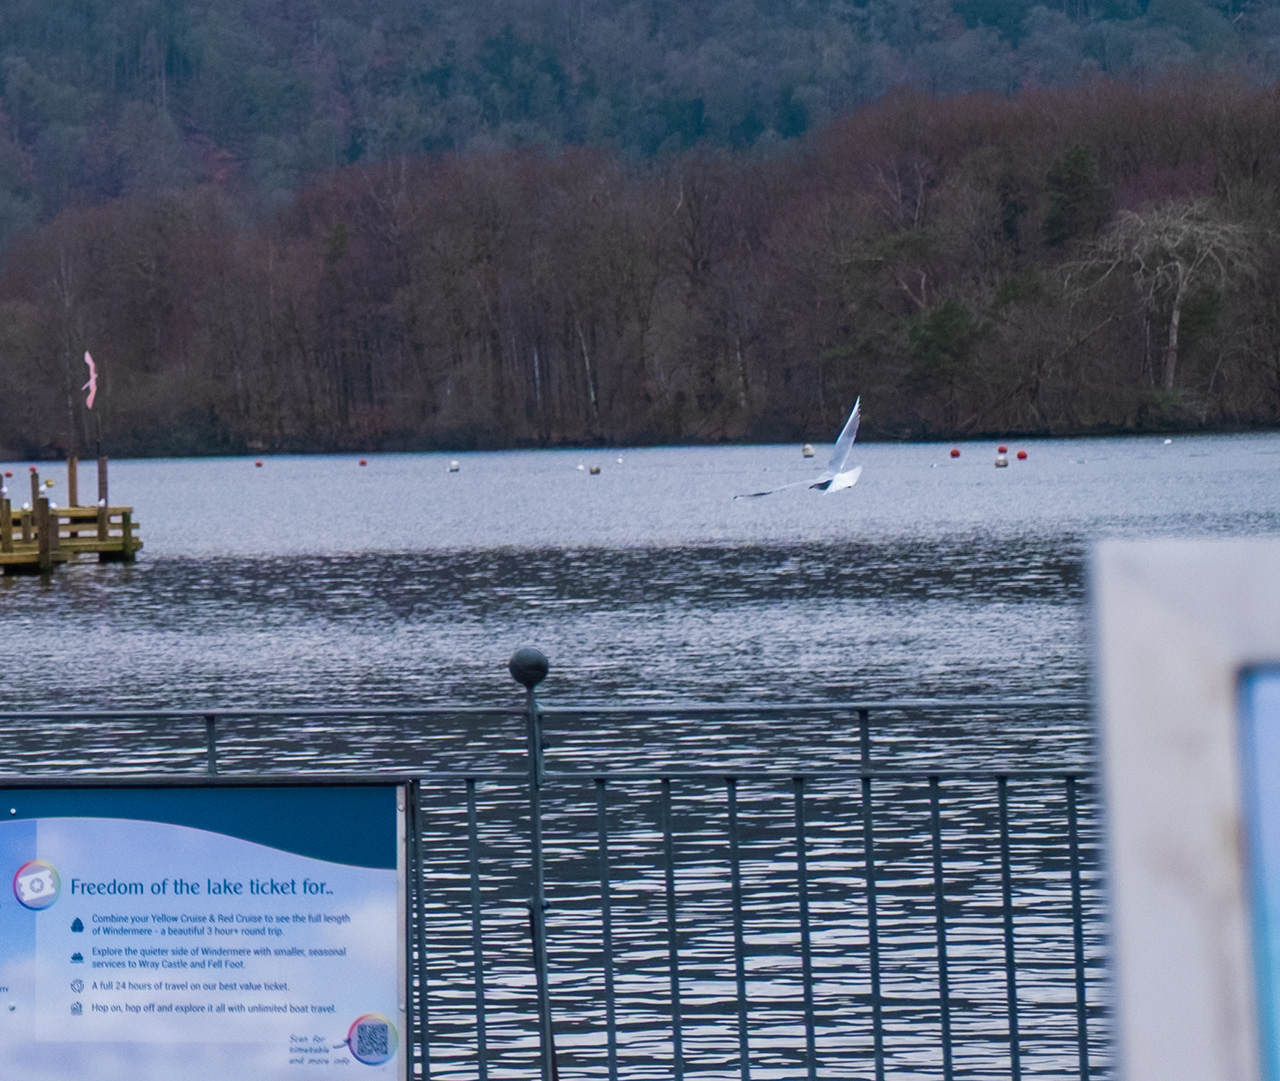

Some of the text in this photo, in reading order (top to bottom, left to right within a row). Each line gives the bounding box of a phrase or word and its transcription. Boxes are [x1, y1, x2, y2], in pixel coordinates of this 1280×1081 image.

[71, 878, 144, 895] Freedom
[150, 878, 169, 895] of
[173, 879, 200, 895] the
[207, 879, 243, 895] lake
[249, 879, 298, 895] ticket
[92, 913, 351, 925] Combine your Yellow Cruise & Red Cruise to see the full length
[92, 926, 100, 935] of
[102, 926, 152, 935] Windermere
[168, 926, 204, 935] beautiful
[207, 926, 213, 935] 3
[241, 926, 265, 935] round
[92, 947, 122, 957] Explore
[124, 947, 138, 956] the
[140, 947, 168, 957] quieter
[171, 947, 188, 956] side
[190, 947, 199, 956] of
[201, 947, 251, 956] Windermere
[254, 947, 271, 956] with
[309, 947, 346, 956] seasonal
[92, 960, 126, 968] services
[128, 960, 137, 968] to
[139, 960, 159, 970] Wray
[162, 960, 187, 968] Castle
[190, 960, 205, 968] and
[208, 960, 222, 968] Fell
[92, 981, 98, 990] A
[100, 981, 113, 990] full
[116, 981, 126, 990] 24
[128, 981, 152, 990] hours
[154, 981, 162, 990] of
[165, 981, 188, 990] travel
[219, 981, 238, 991] best
[240, 982, 262, 991] value
[92, 1003, 109, 1013] Hop
[125, 1003, 141, 1014] hop
[143, 1003, 155, 1012] off
[157, 1003, 173, 1013] and
[175, 1003, 205, 1014] explore
[208, 1003, 213, 1013] it
[215, 1003, 225, 1013] all
[228, 1004, 245, 1013] with
[248, 1004, 287, 1013] unlimited
[289, 1004, 308, 1013] boat
